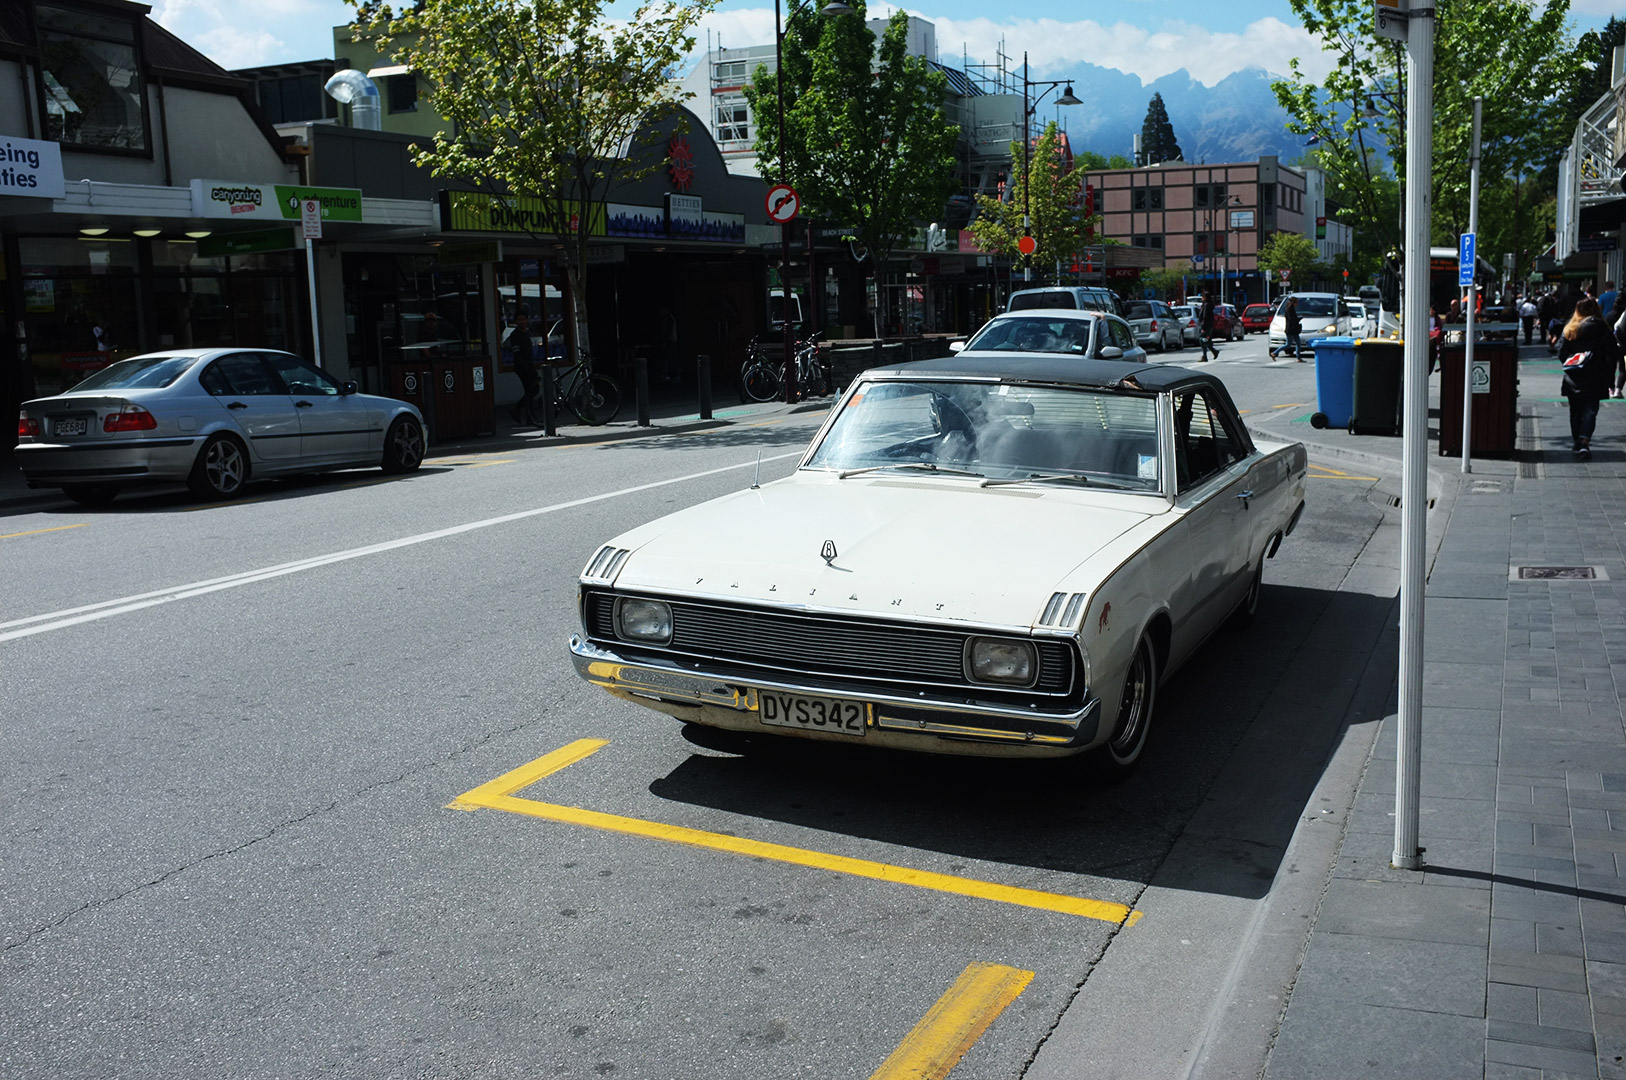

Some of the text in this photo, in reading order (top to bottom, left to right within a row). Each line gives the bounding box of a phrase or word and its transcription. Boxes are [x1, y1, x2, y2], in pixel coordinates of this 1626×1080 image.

[0, 167, 38, 188] ties
[211, 187, 262, 206] canyoning
[672, 197, 700, 208] HETTIES
[822, 228, 854, 237] BEACH STREET
[1465, 236, 1470, 250] P
[1465, 250, 1470, 261] 5
[1115, 269, 1133, 277] KFC
[56, 421, 85, 433] FGE684
[762, 694, 861, 731] DYS342
